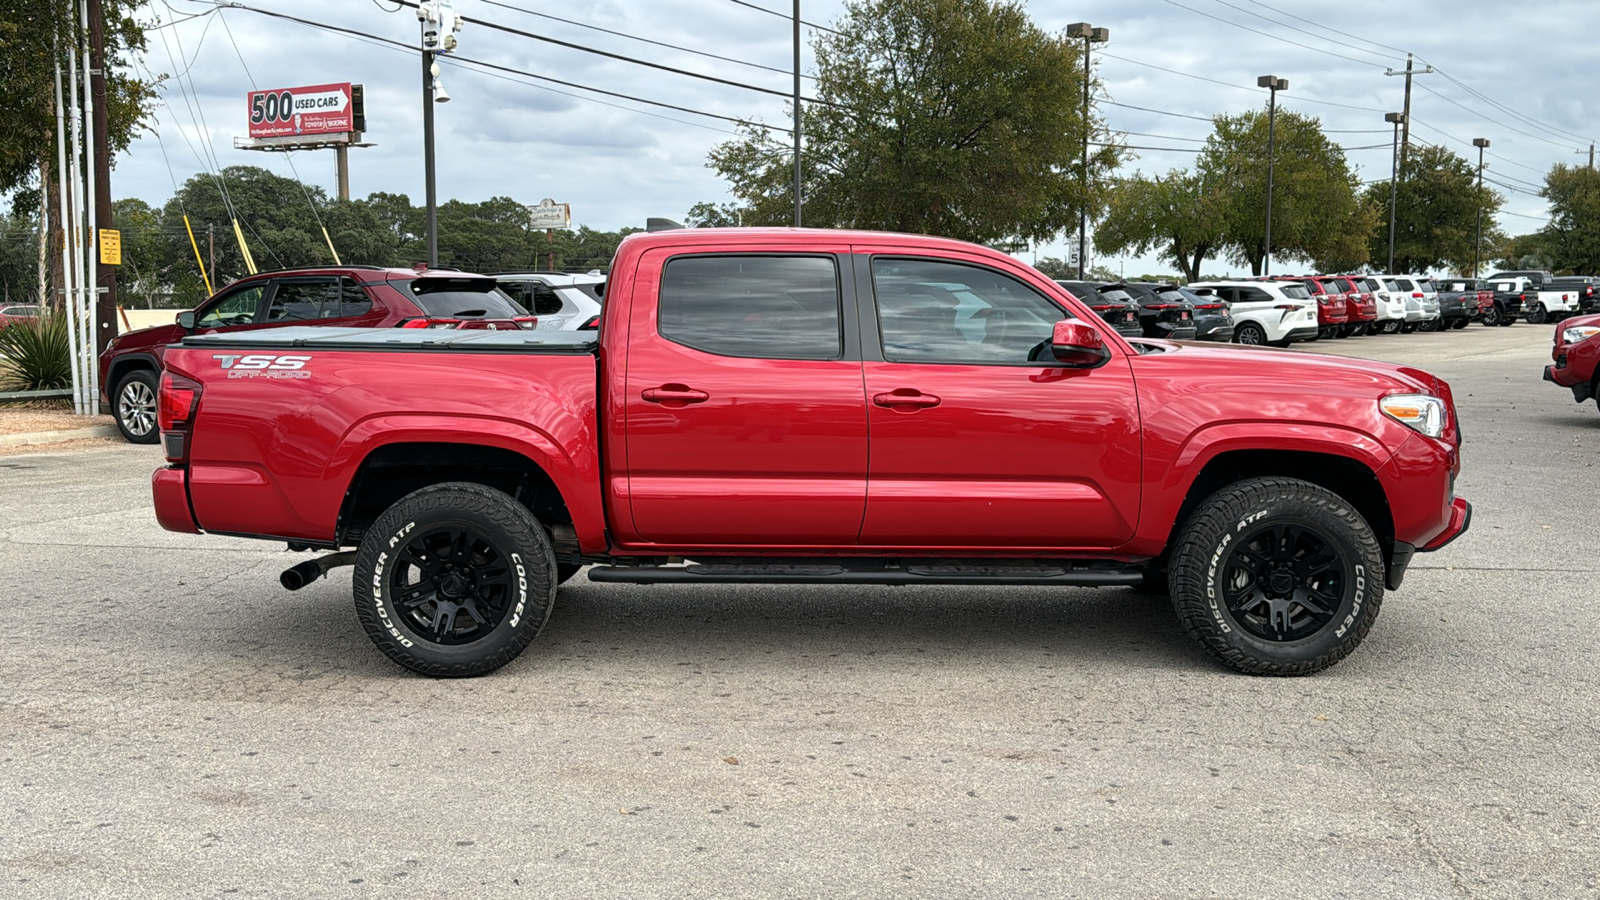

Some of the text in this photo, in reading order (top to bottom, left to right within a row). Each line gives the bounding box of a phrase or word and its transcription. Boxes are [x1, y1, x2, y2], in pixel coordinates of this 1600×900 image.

[251, 91, 293, 124] 500
[295, 97, 338, 109] USED CARS
[304, 119, 348, 128] TOYOTA BOERNE
[212, 354, 313, 370] TSS
[227, 369, 312, 379] OFF-ROAD
[372, 521, 416, 648] DISCOVERER ATP
[1206, 509, 1268, 634] DISCOVERER ATP
[509, 552, 528, 628] COOPER
[1334, 563, 1366, 638] COOPER
